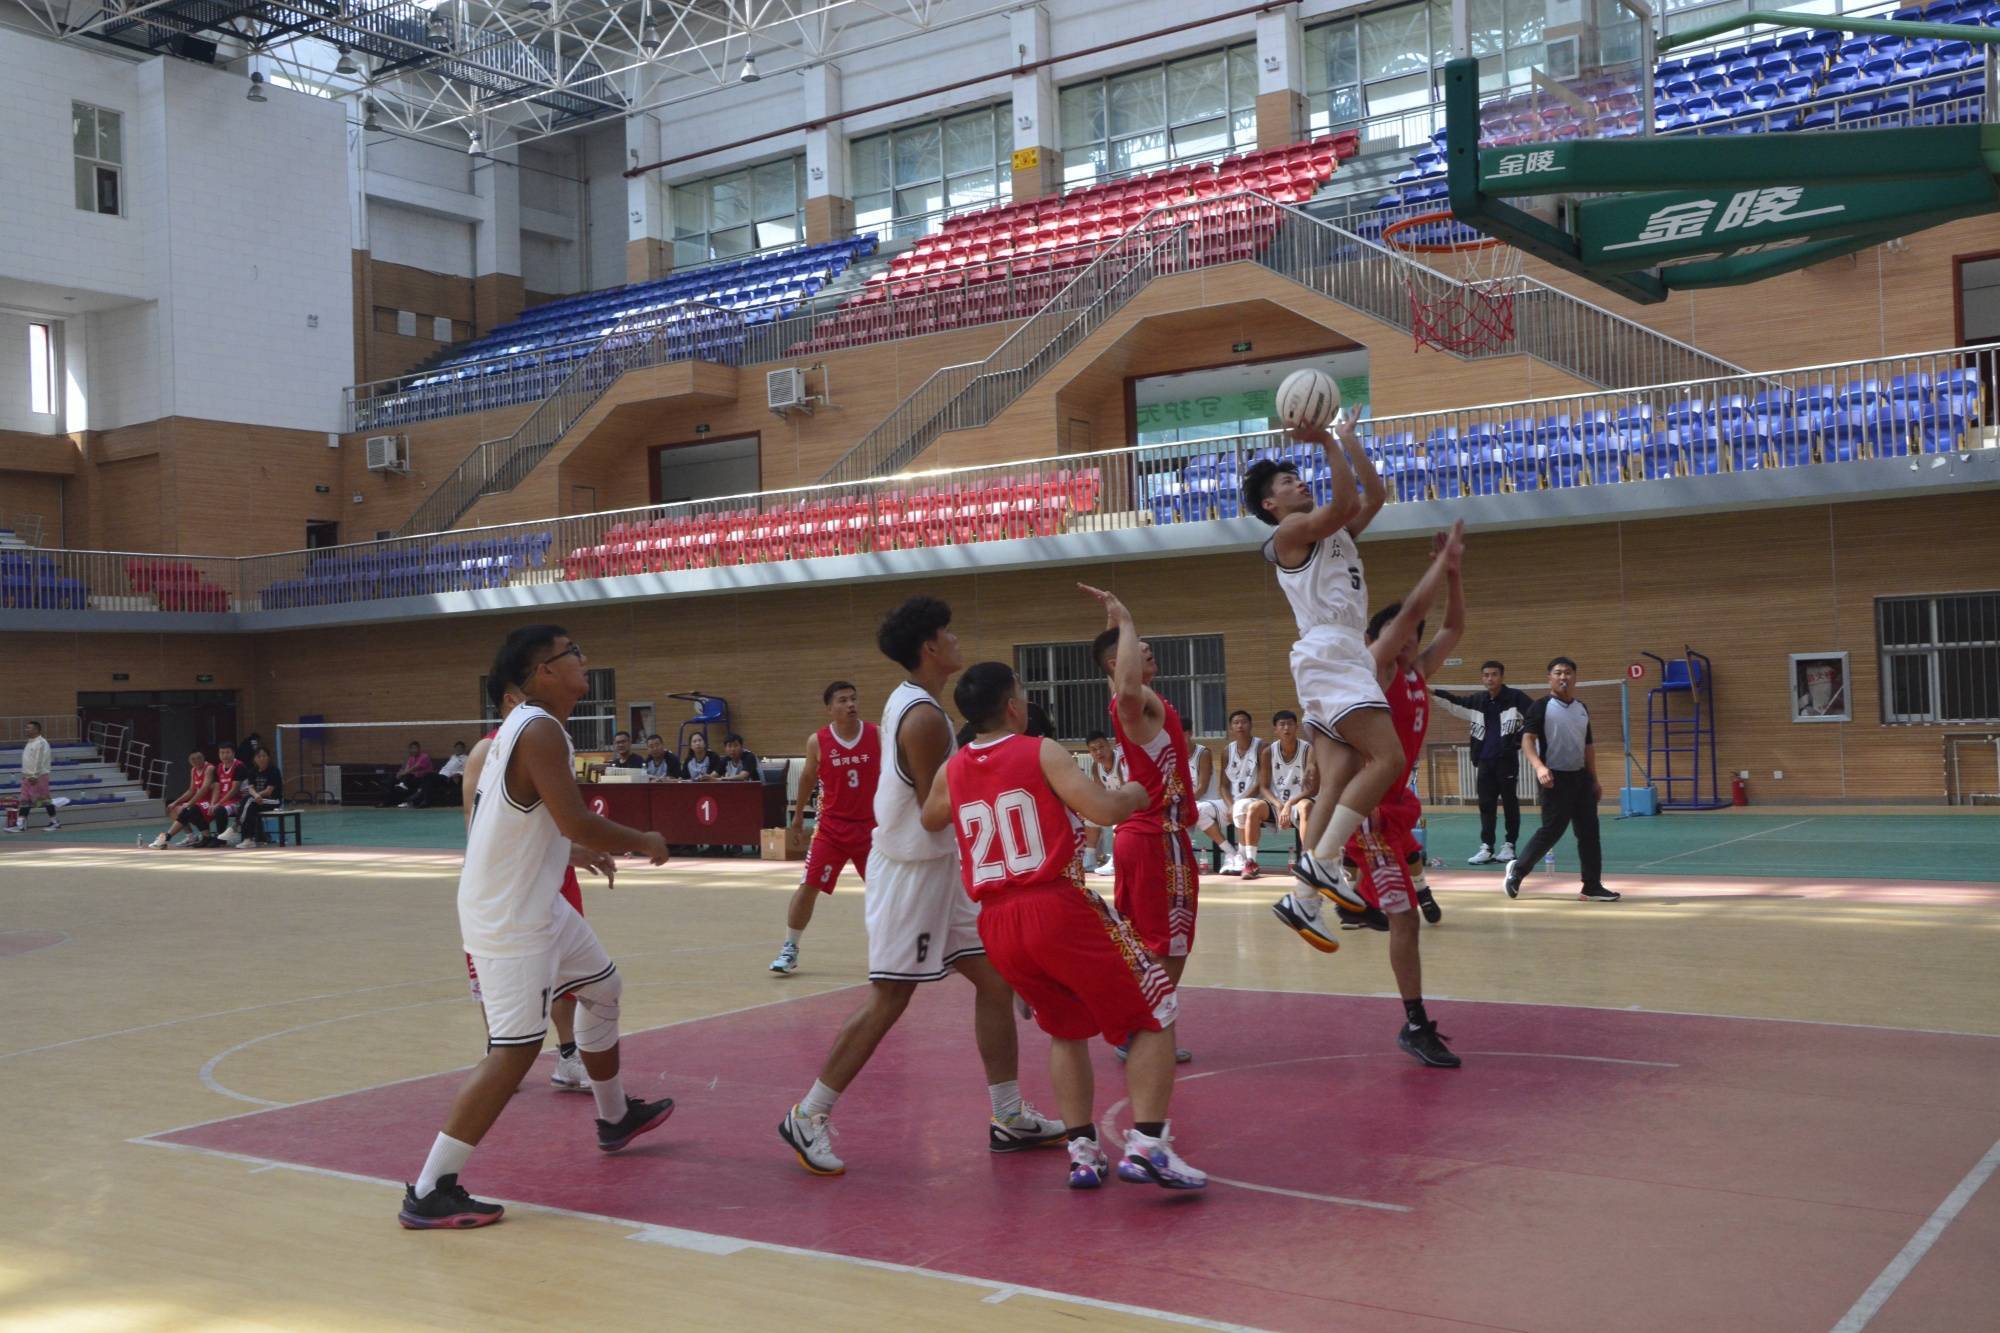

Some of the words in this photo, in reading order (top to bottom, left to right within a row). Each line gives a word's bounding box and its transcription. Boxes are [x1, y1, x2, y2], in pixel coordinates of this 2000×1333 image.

[1486, 150, 1564, 179] 金陵
[1604, 186, 1843, 250] 金陵
[1347, 566, 1361, 590] 5
[1631, 665, 1643, 678] D
[847, 769, 859, 788] 3
[593, 799, 605, 817] 2
[701, 800, 710, 821] 1
[959, 787, 1047, 887] 20
[820, 864, 833, 883] 3
[916, 932, 931, 963] 6
